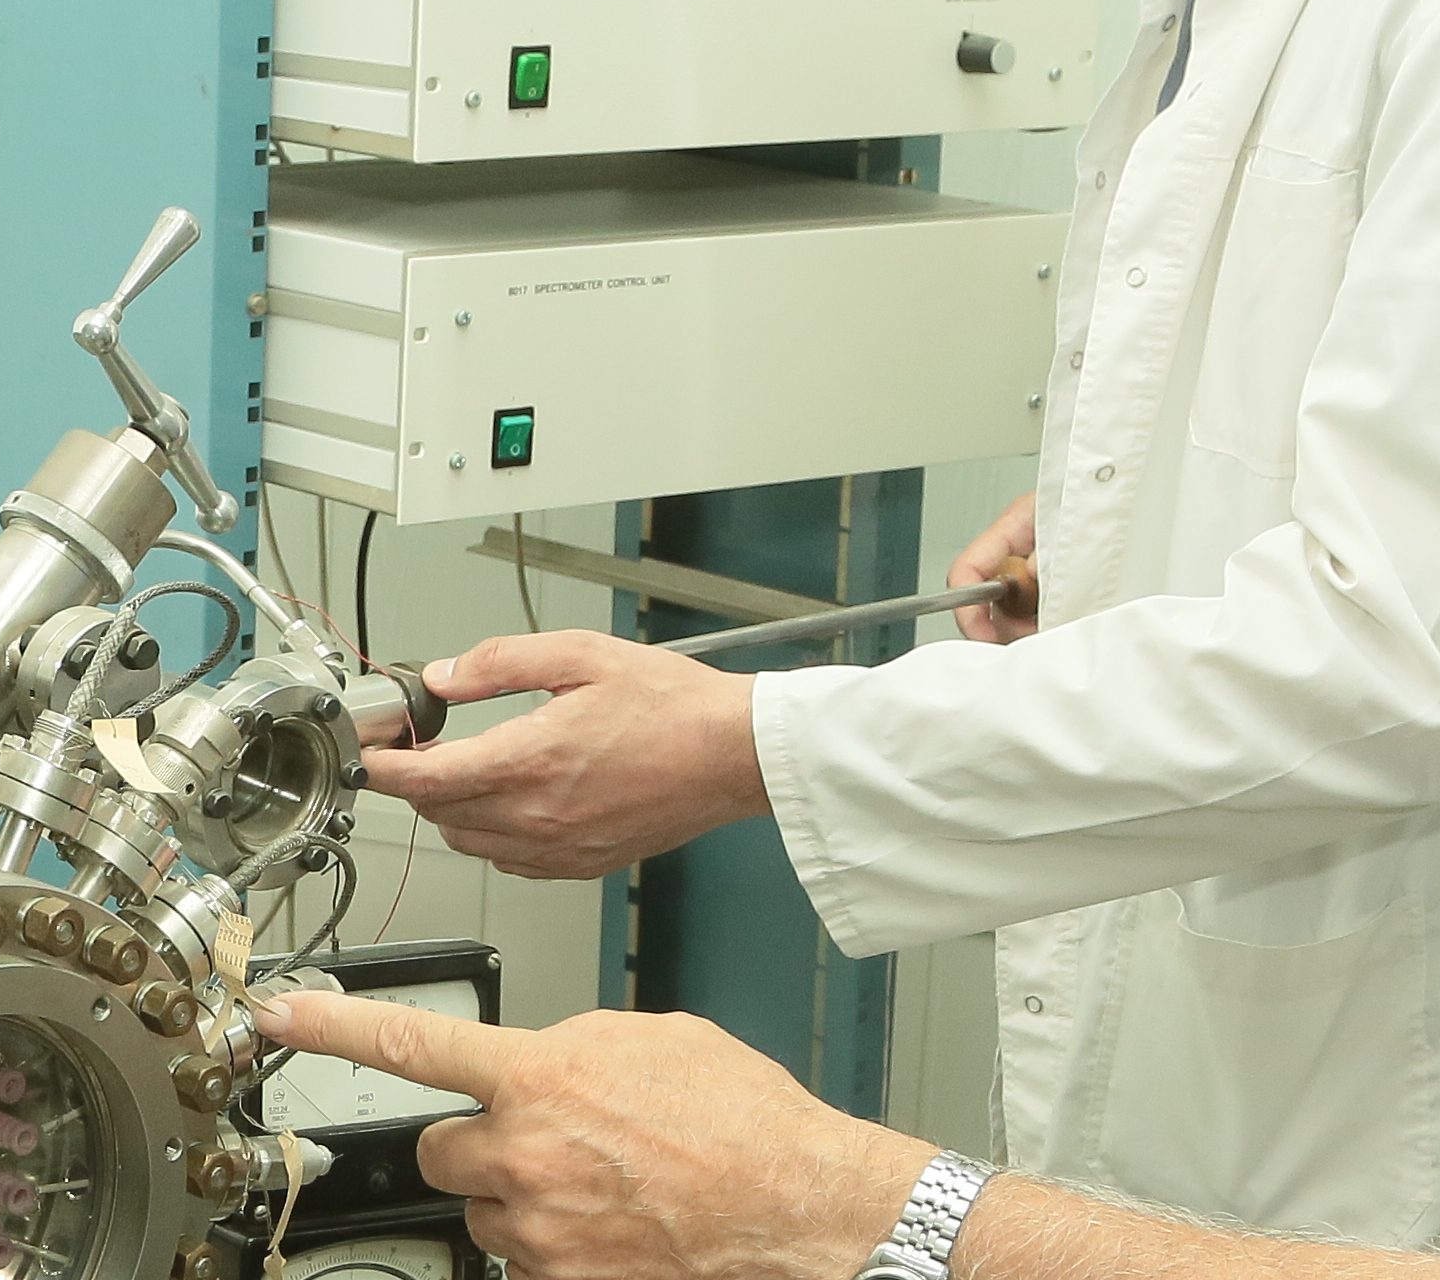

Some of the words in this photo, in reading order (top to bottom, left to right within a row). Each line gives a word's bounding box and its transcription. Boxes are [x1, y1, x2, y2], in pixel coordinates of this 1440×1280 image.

[534, 280, 603, 294] SPECTROMETER
[607, 277, 648, 289] CONTROL
[651, 274, 671, 285] UNIT
